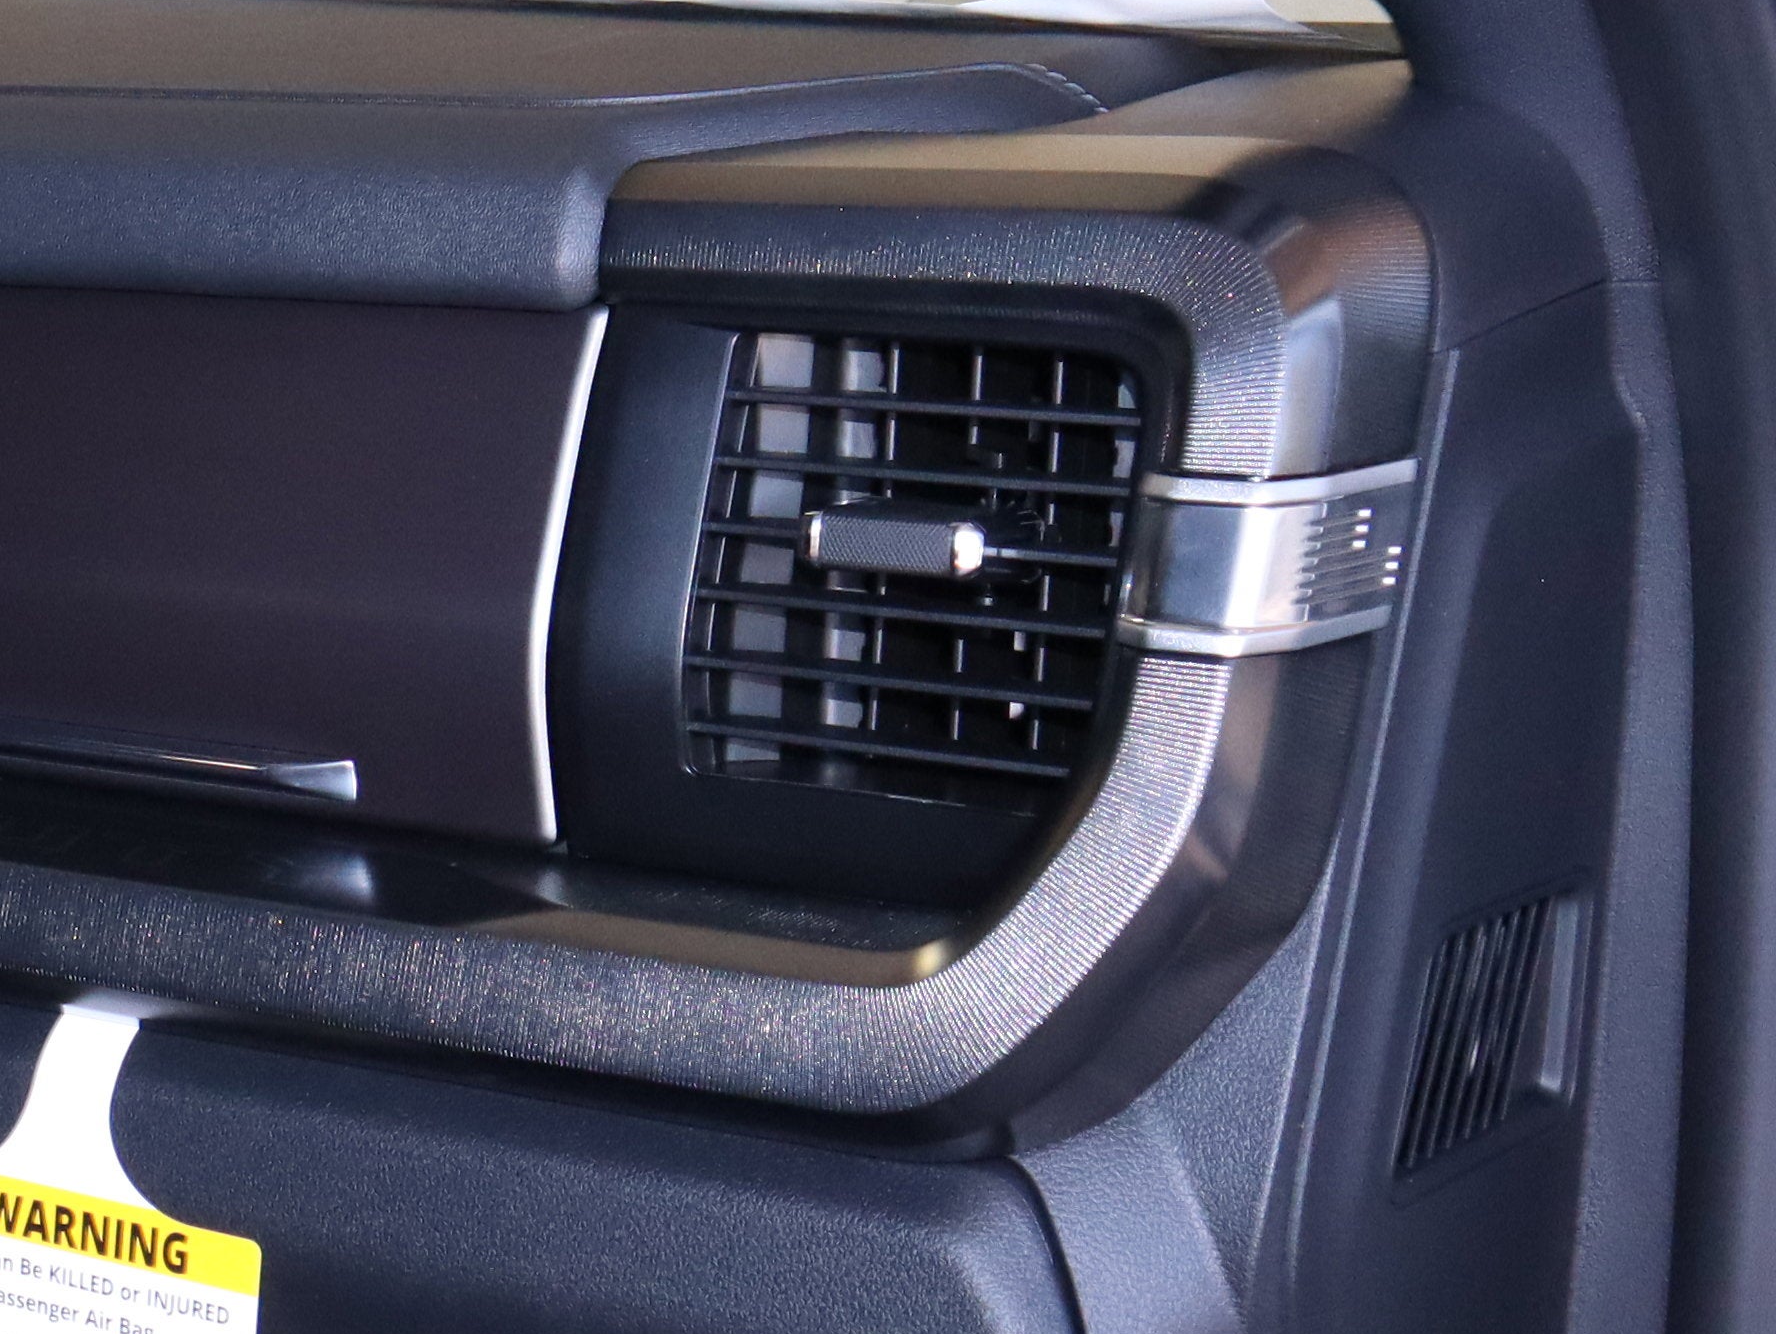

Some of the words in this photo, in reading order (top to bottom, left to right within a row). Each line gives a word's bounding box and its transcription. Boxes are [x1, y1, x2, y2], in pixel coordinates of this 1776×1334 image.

[19, 1257, 43, 1280] Be
[48, 1266, 114, 1296] KILLED
[120, 1286, 141, 1303] or
[147, 1289, 230, 1325] INJURED
[85, 1309, 113, 1331] Air
